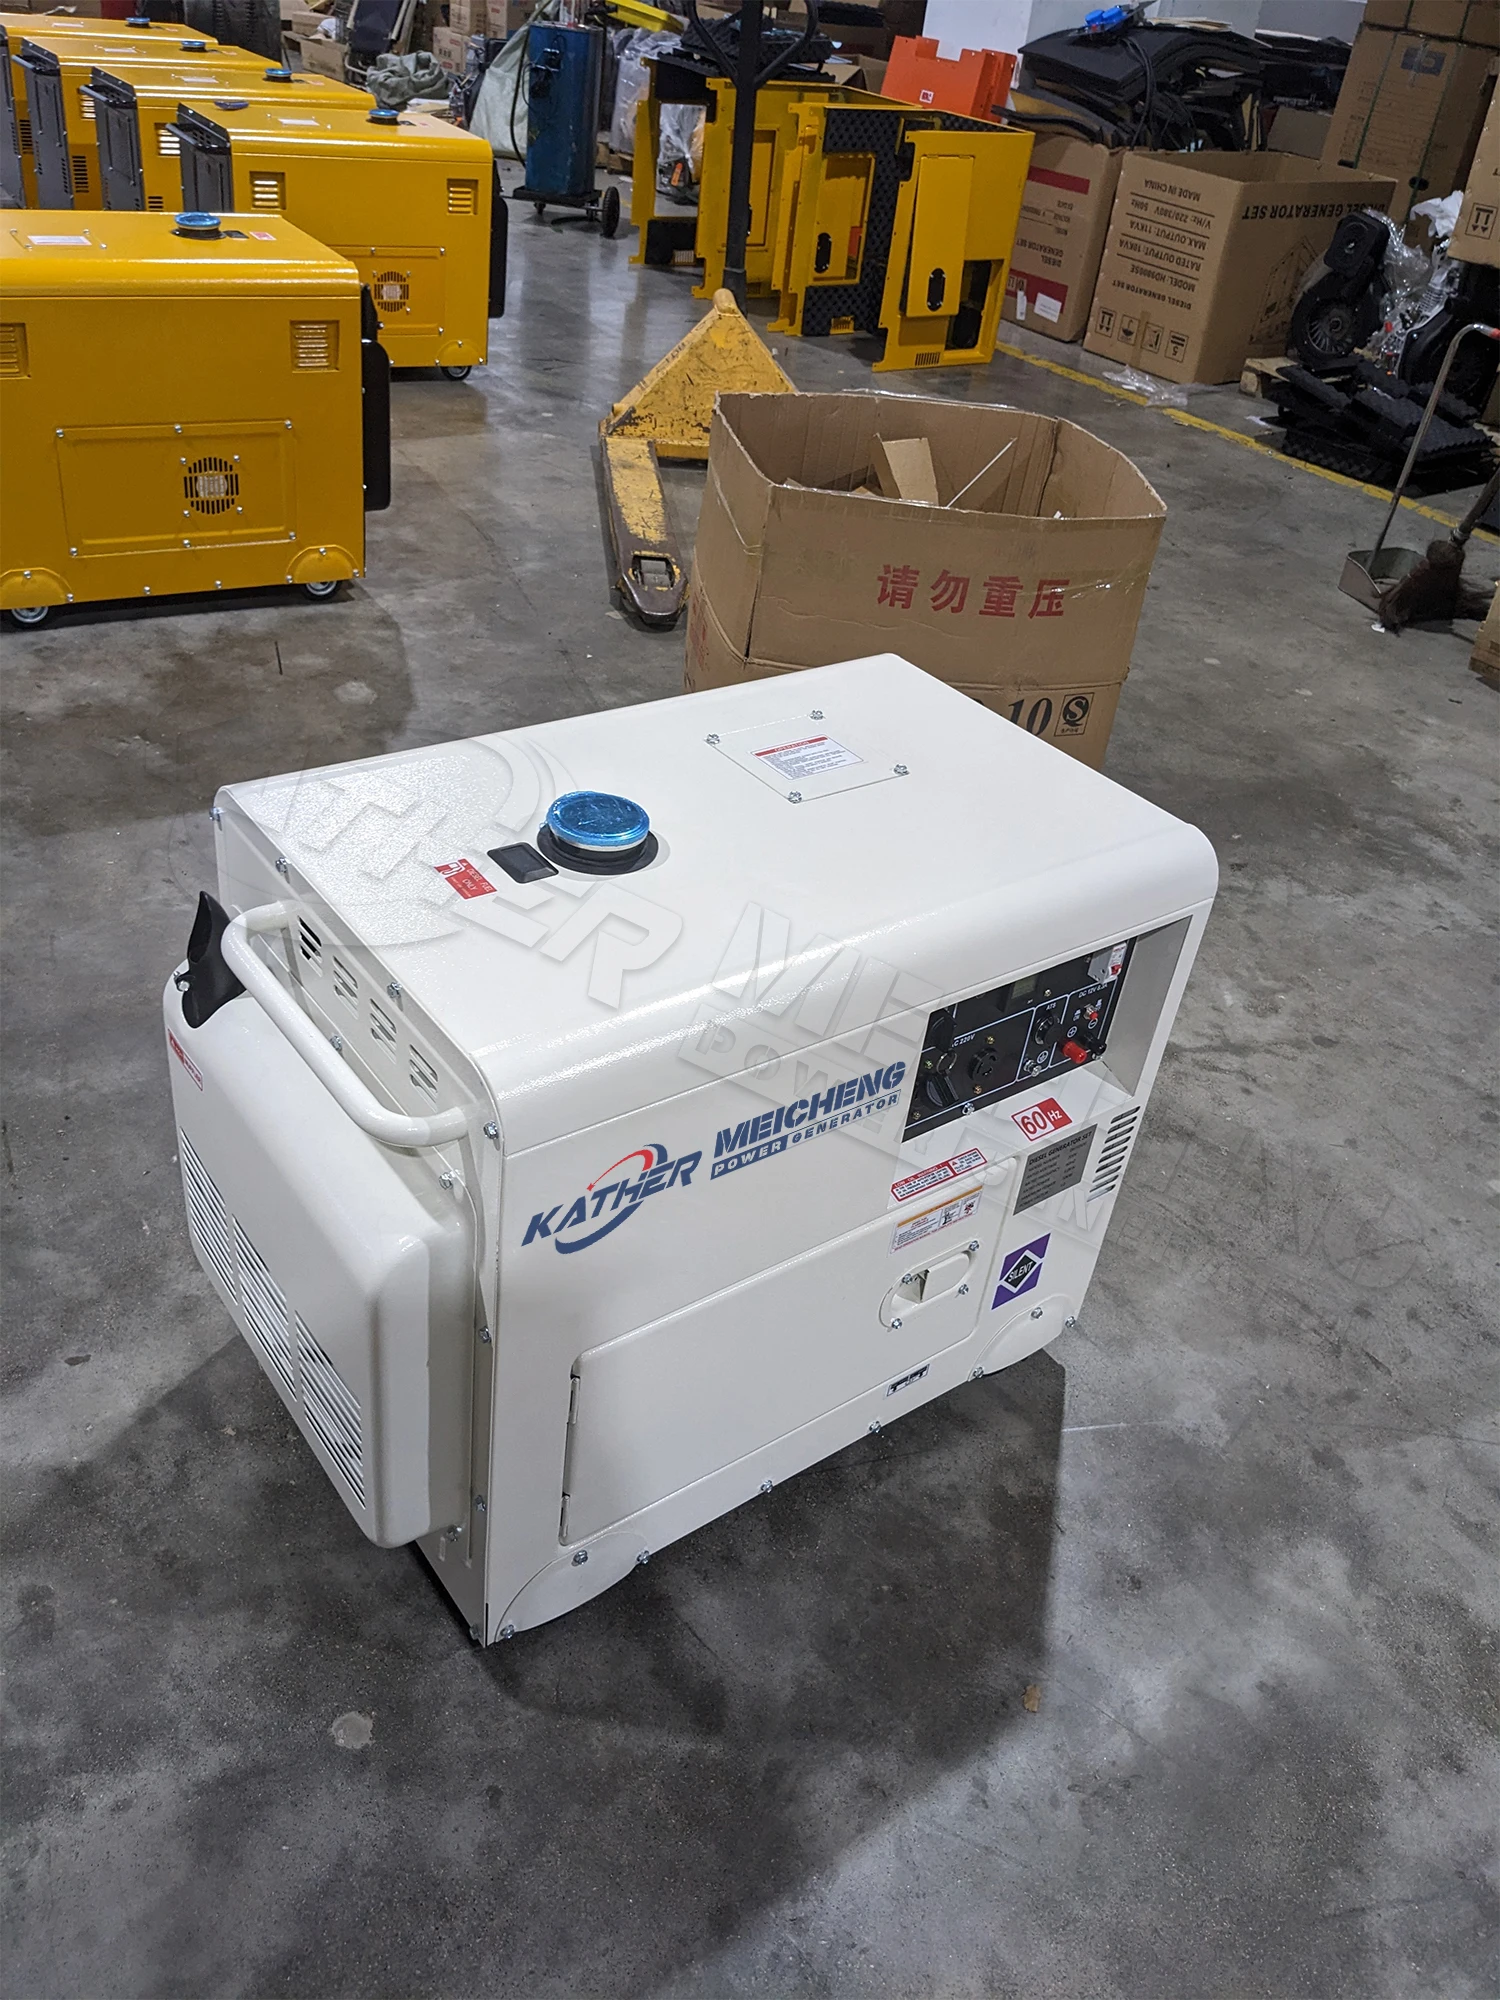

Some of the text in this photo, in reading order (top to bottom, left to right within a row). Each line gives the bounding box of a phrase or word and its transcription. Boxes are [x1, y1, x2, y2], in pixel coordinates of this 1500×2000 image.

[1144, 179, 1201, 201] MADE IN CHINA
[1242, 205, 1268, 220] SET
[1270, 203, 1343, 219] GENERATOR
[1129, 220, 1152, 234] 11KVA
[1176, 257, 1201, 271] RATED
[1112, 279, 1191, 310] DIESEL GENERATOR SET
[1167, 276, 1196, 292] MODEL:
[876, 564, 1072, 619] 请勿重压
[462, 878, 479, 891] ONLY
[467, 868, 482, 882] DIESEL
[481, 882, 493, 892] FUEL
[959, 1033, 976, 1045] 220V
[713, 1061, 907, 1158] MEICHENG
[1020, 1109, 1062, 1135] 60 Hz
[714, 1093, 900, 1177] POWER GENERATOR
[1029, 1131, 1092, 1166] DIESEL GENERATOR SET
[521, 1150, 703, 1247] KATHER
[1007, 1261, 1034, 1282] SILENT
